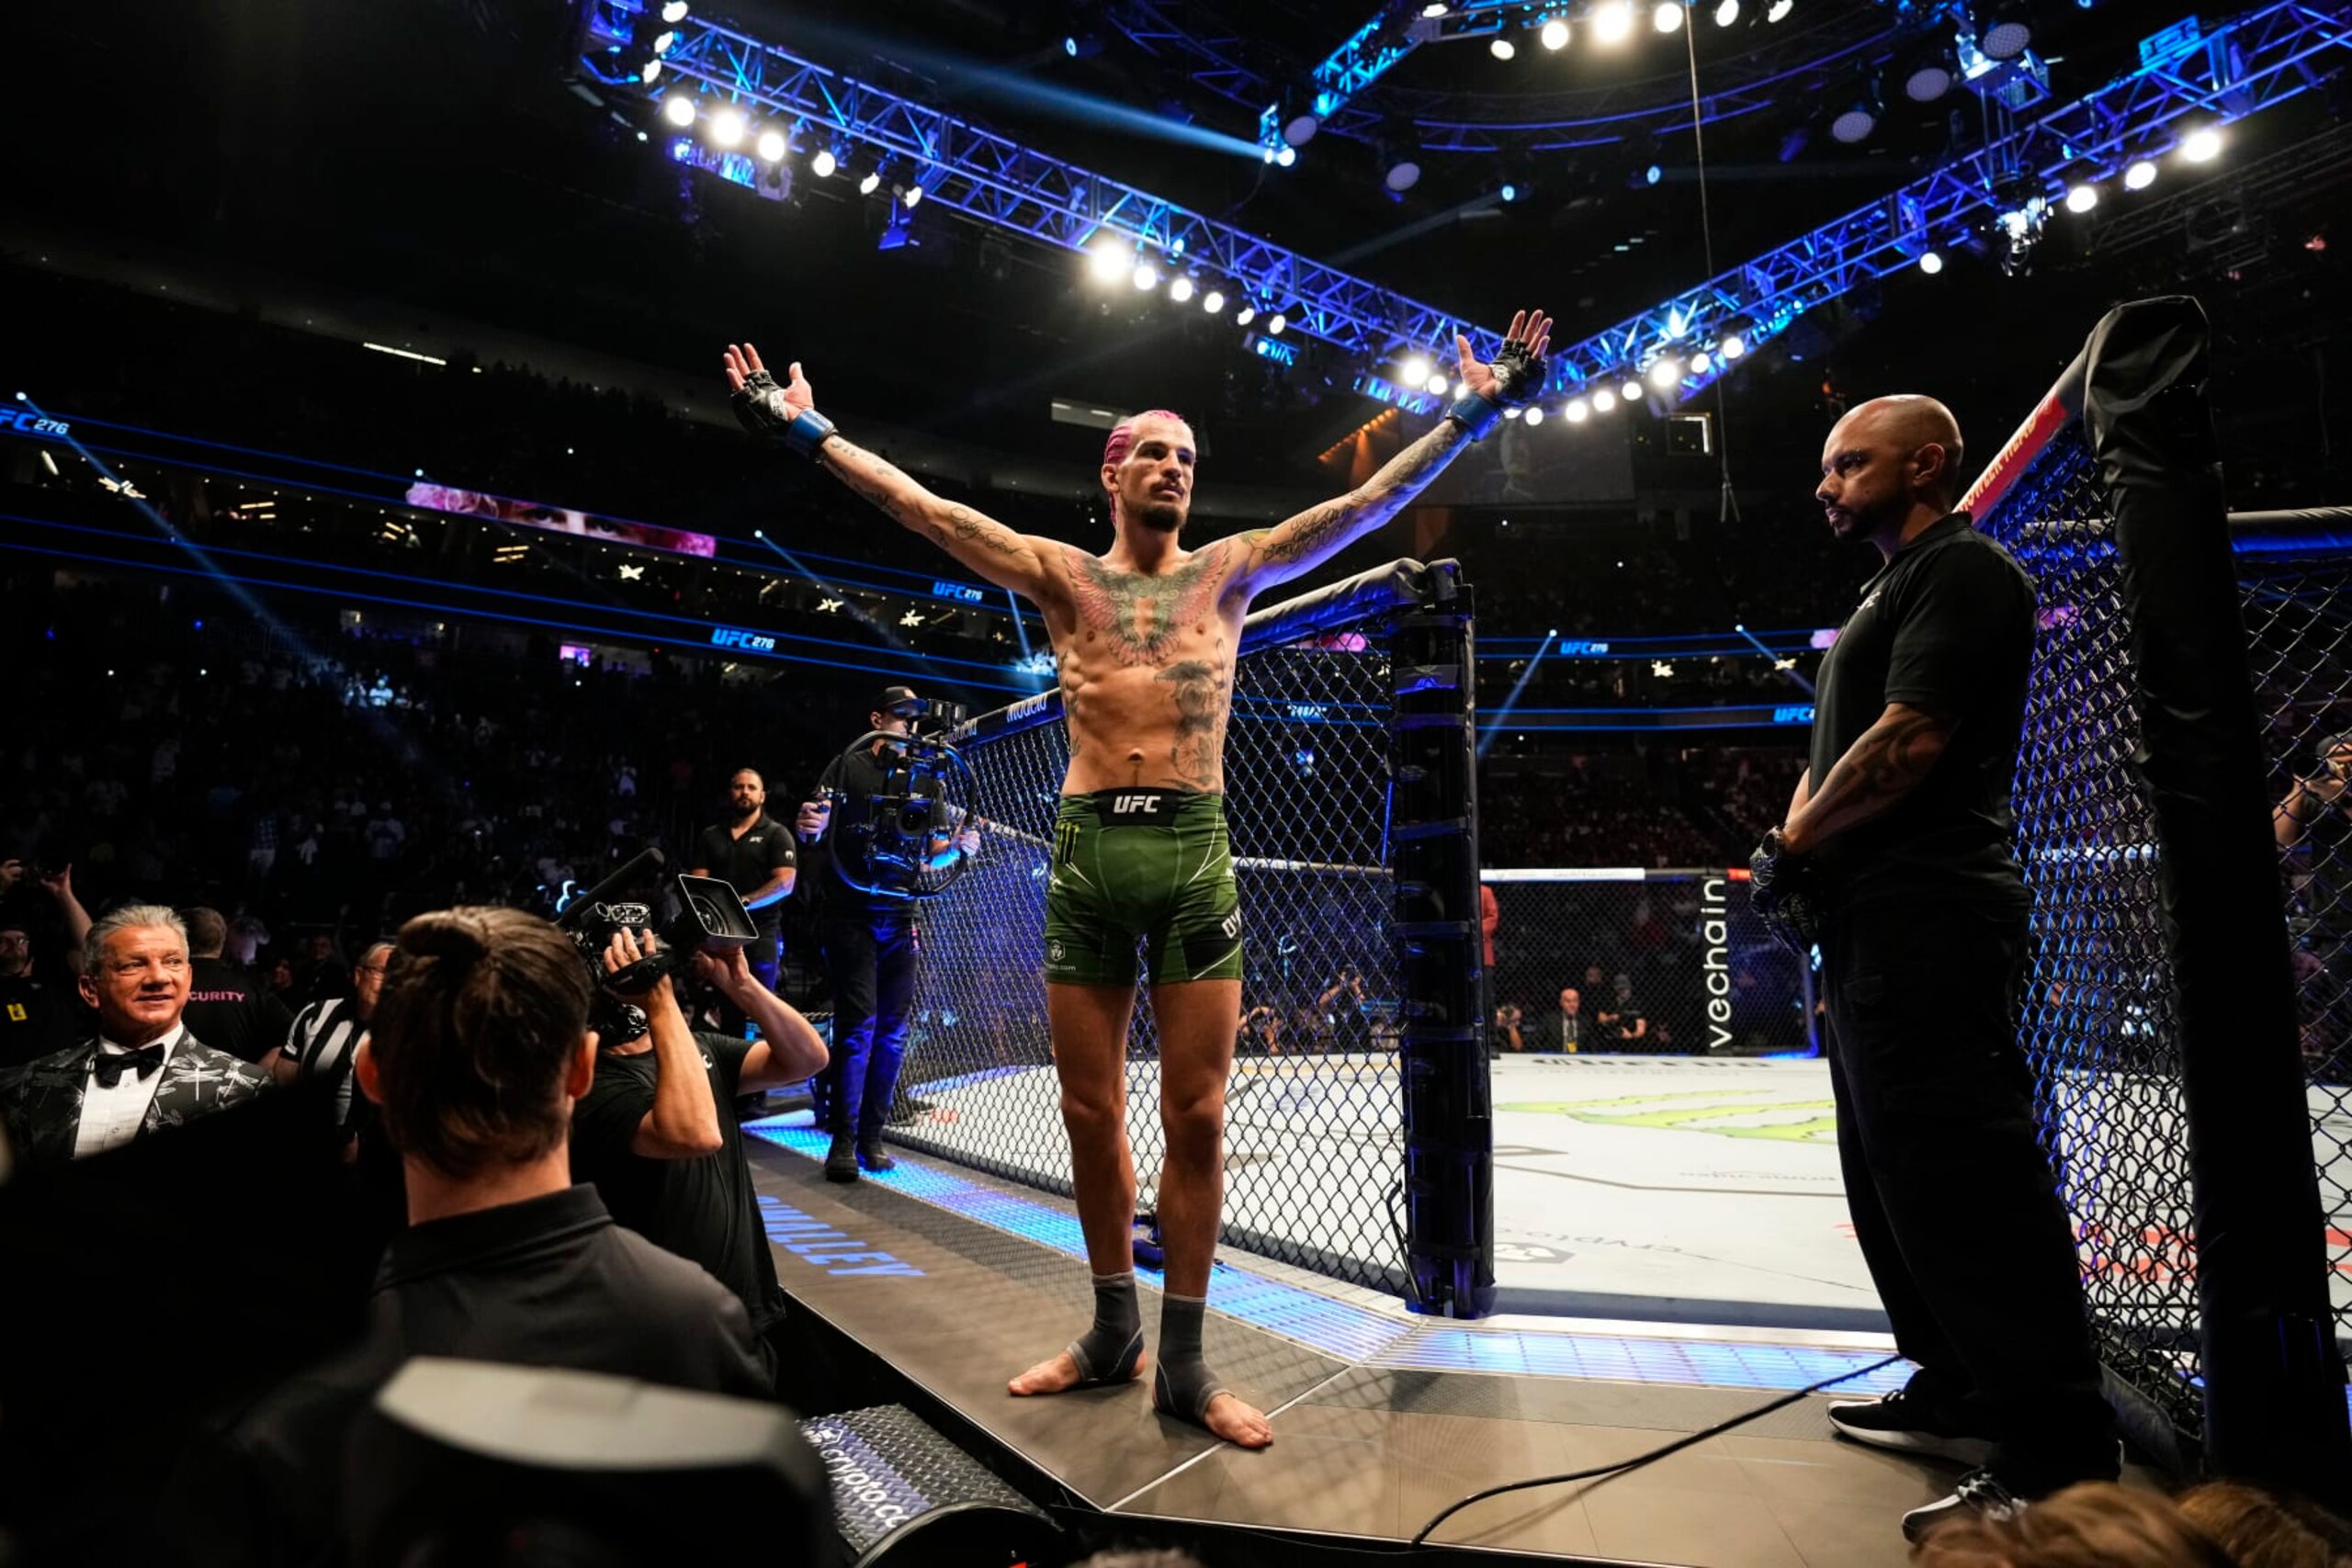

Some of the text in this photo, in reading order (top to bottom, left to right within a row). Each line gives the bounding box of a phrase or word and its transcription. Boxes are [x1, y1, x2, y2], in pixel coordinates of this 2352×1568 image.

[34, 419, 71, 434] 276
[933, 581, 967, 599] UFC
[711, 628, 755, 649] UFC
[1560, 642, 1592, 654] UFC
[1773, 706, 1811, 722] UFC
[1113, 795, 1161, 814] UFC
[1701, 879, 1733, 1048] vechain
